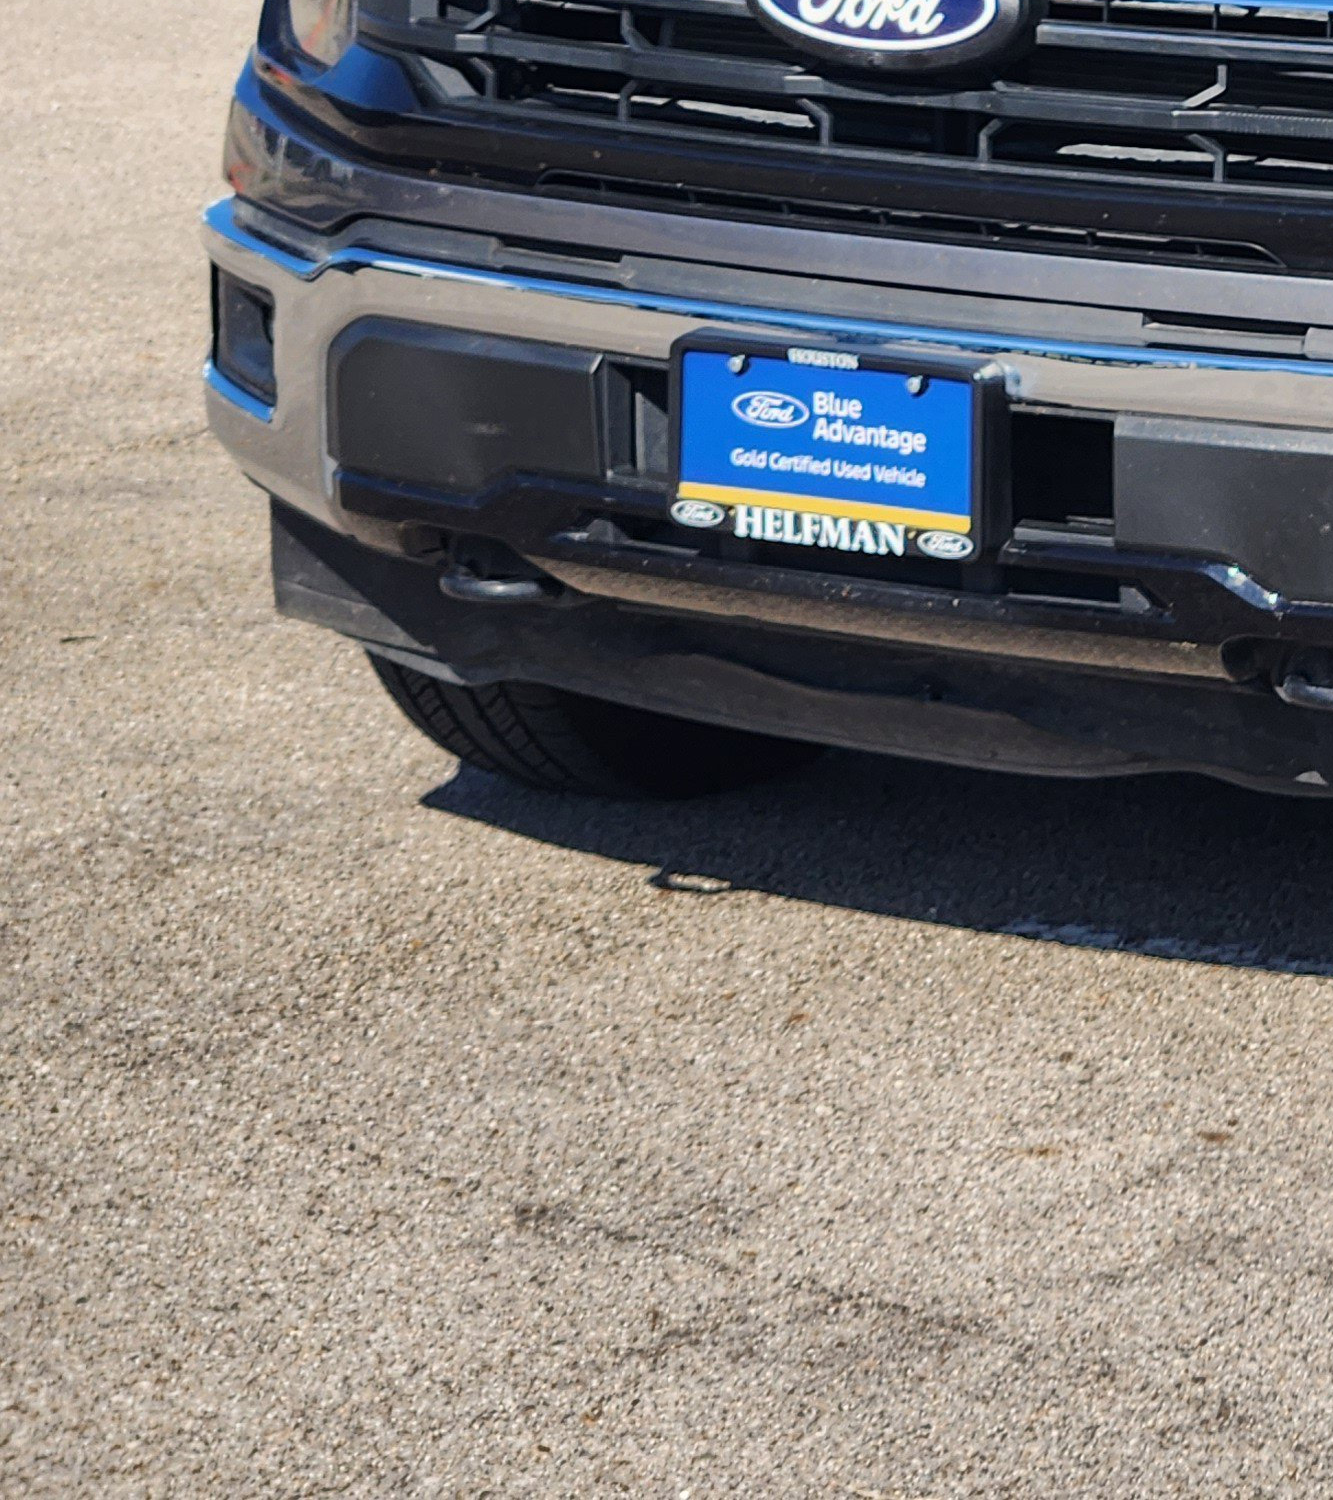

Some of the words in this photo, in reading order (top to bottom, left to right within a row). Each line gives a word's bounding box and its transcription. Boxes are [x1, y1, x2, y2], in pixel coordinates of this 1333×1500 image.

[787, 347, 860, 371] HOUSTON
[744, 393, 796, 424] Ford
[811, 391, 863, 420] Blue
[811, 418, 928, 456] Advantage
[729, 447, 767, 469] Gold
[769, 451, 831, 477] Certified
[833, 460, 872, 481] Used
[874, 464, 927, 489] Vehicle
[732, 503, 908, 558] HELFMAN
